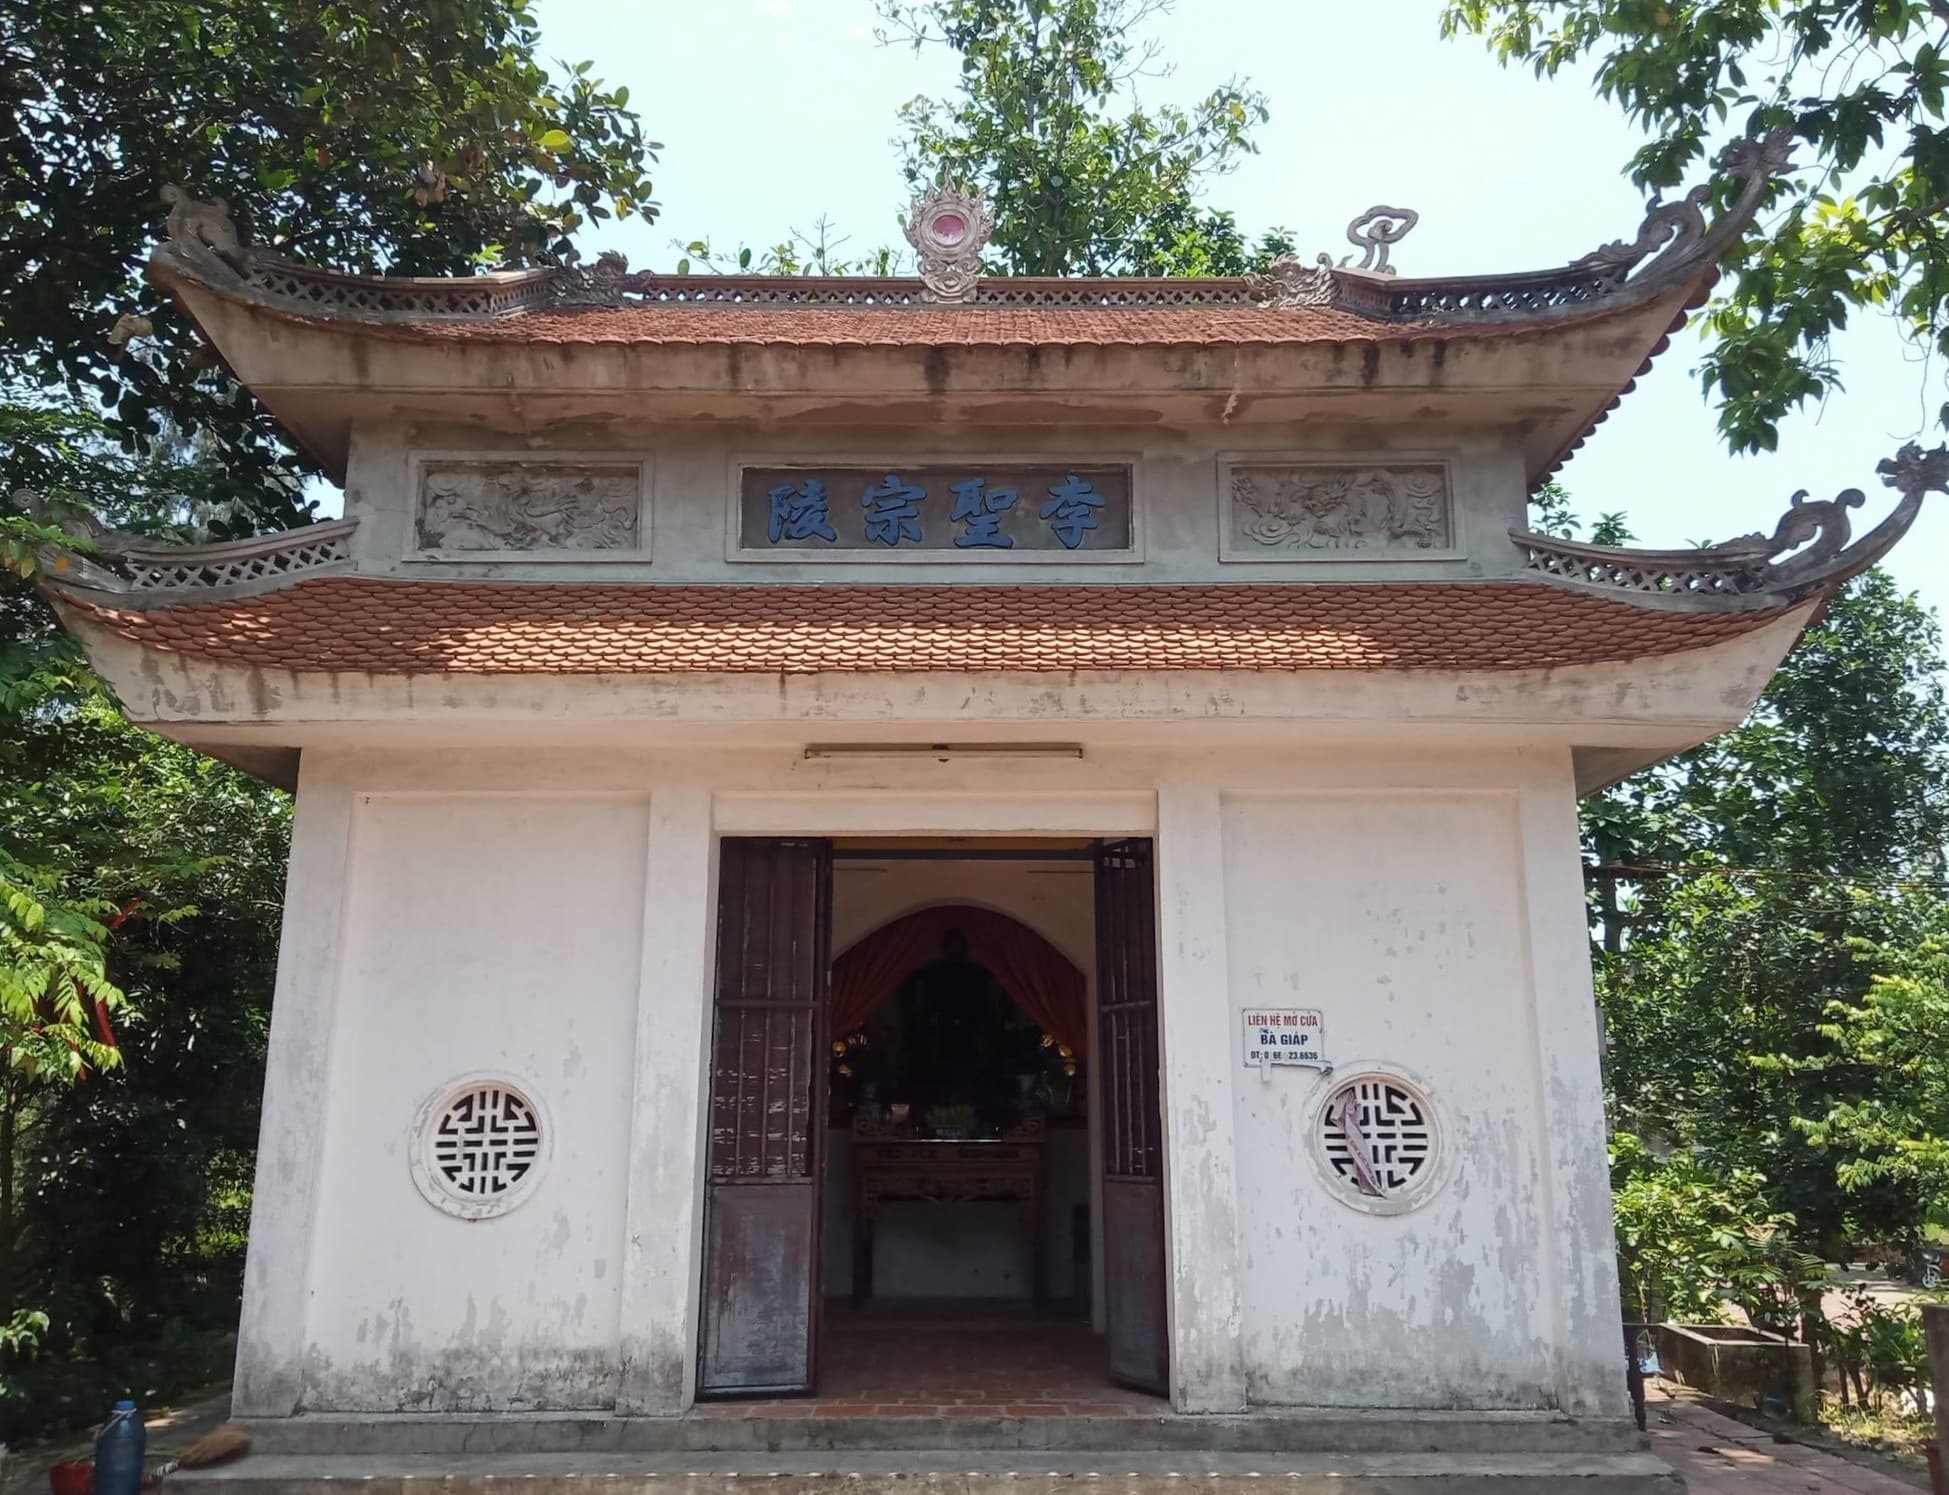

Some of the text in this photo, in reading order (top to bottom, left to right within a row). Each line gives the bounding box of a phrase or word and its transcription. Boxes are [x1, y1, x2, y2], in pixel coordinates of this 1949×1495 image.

[1248, 1012, 1268, 1026] LIÊN
[1260, 1031, 1308, 1045] BÀ GIÁP
